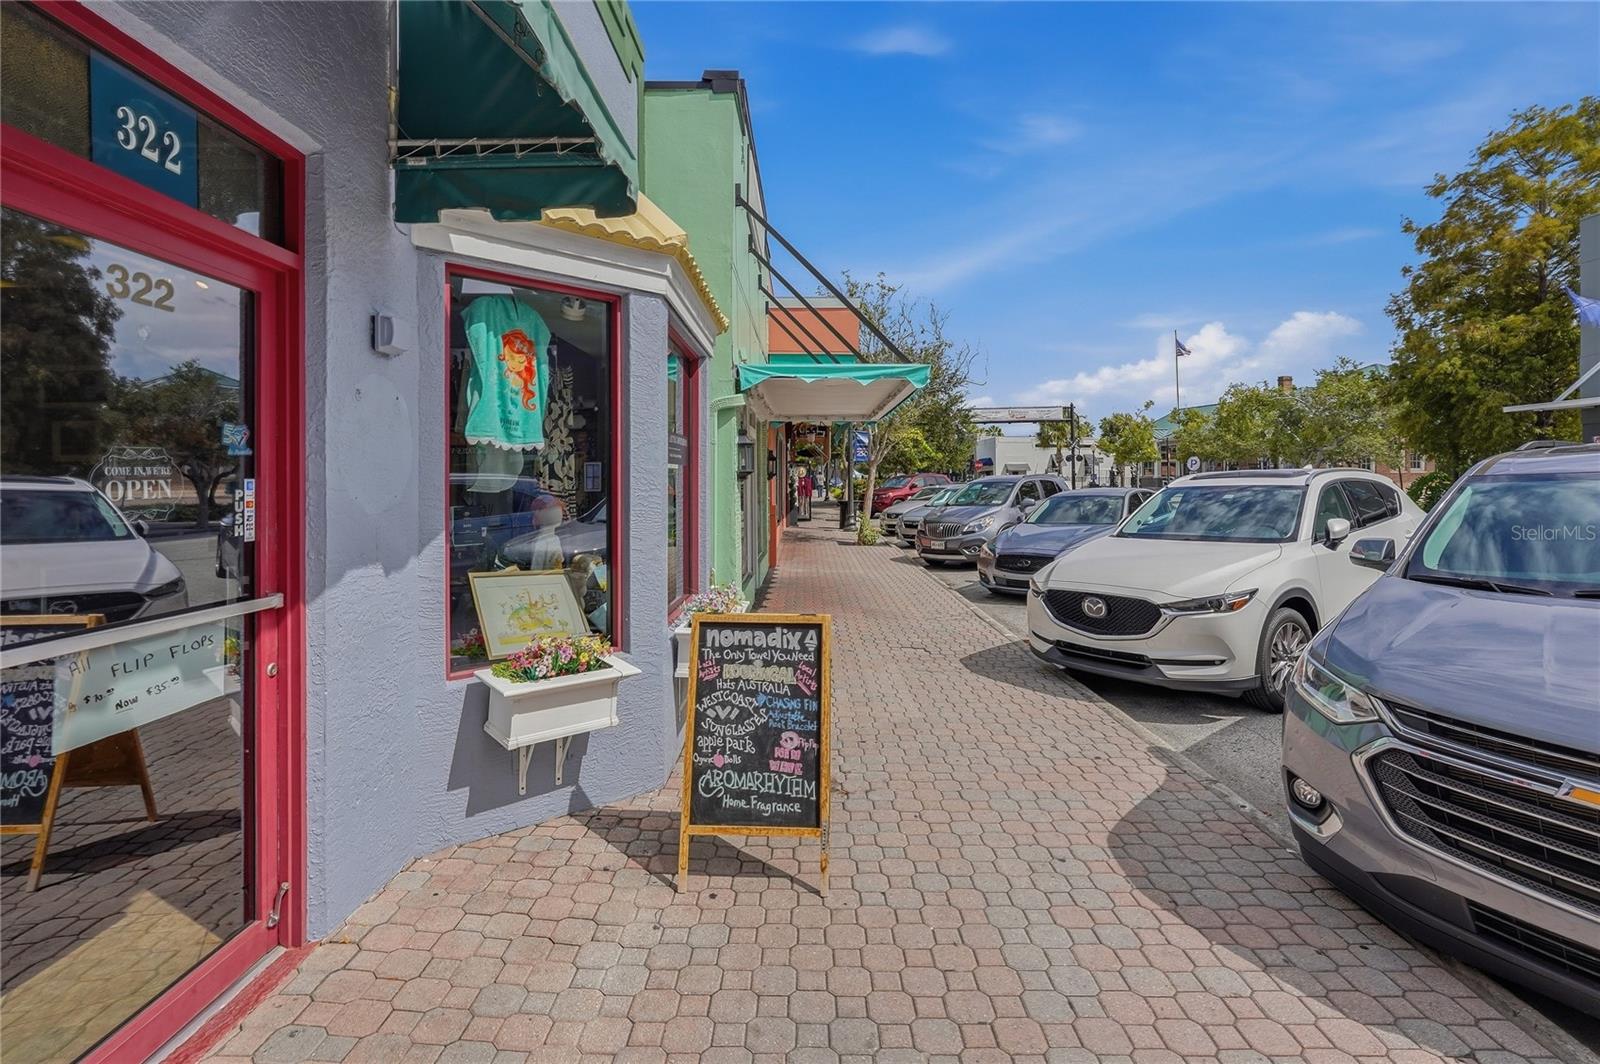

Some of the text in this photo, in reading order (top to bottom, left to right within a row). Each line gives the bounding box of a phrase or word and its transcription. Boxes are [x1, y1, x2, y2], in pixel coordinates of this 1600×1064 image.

[116, 106, 181, 175] 322
[106, 263, 175, 313] 322
[104, 466, 131, 476] COME
[1190, 459, 1198, 468] P
[105, 479, 172, 502] OPEN
[234, 489, 244, 536] PUSH
[706, 626, 802, 650] nomadix
[111, 653, 154, 677] FLIP
[169, 634, 214, 659] FLOPS
[701, 648, 815, 663] The Only Towel You Need
[716, 679, 791, 697] Hats AUSTRALIA
[701, 708, 768, 736] SUNGLASSES
[697, 735, 724, 753] apple
[724, 754, 742, 765] Dolls
[722, 794, 802, 816] Home Fragrance
